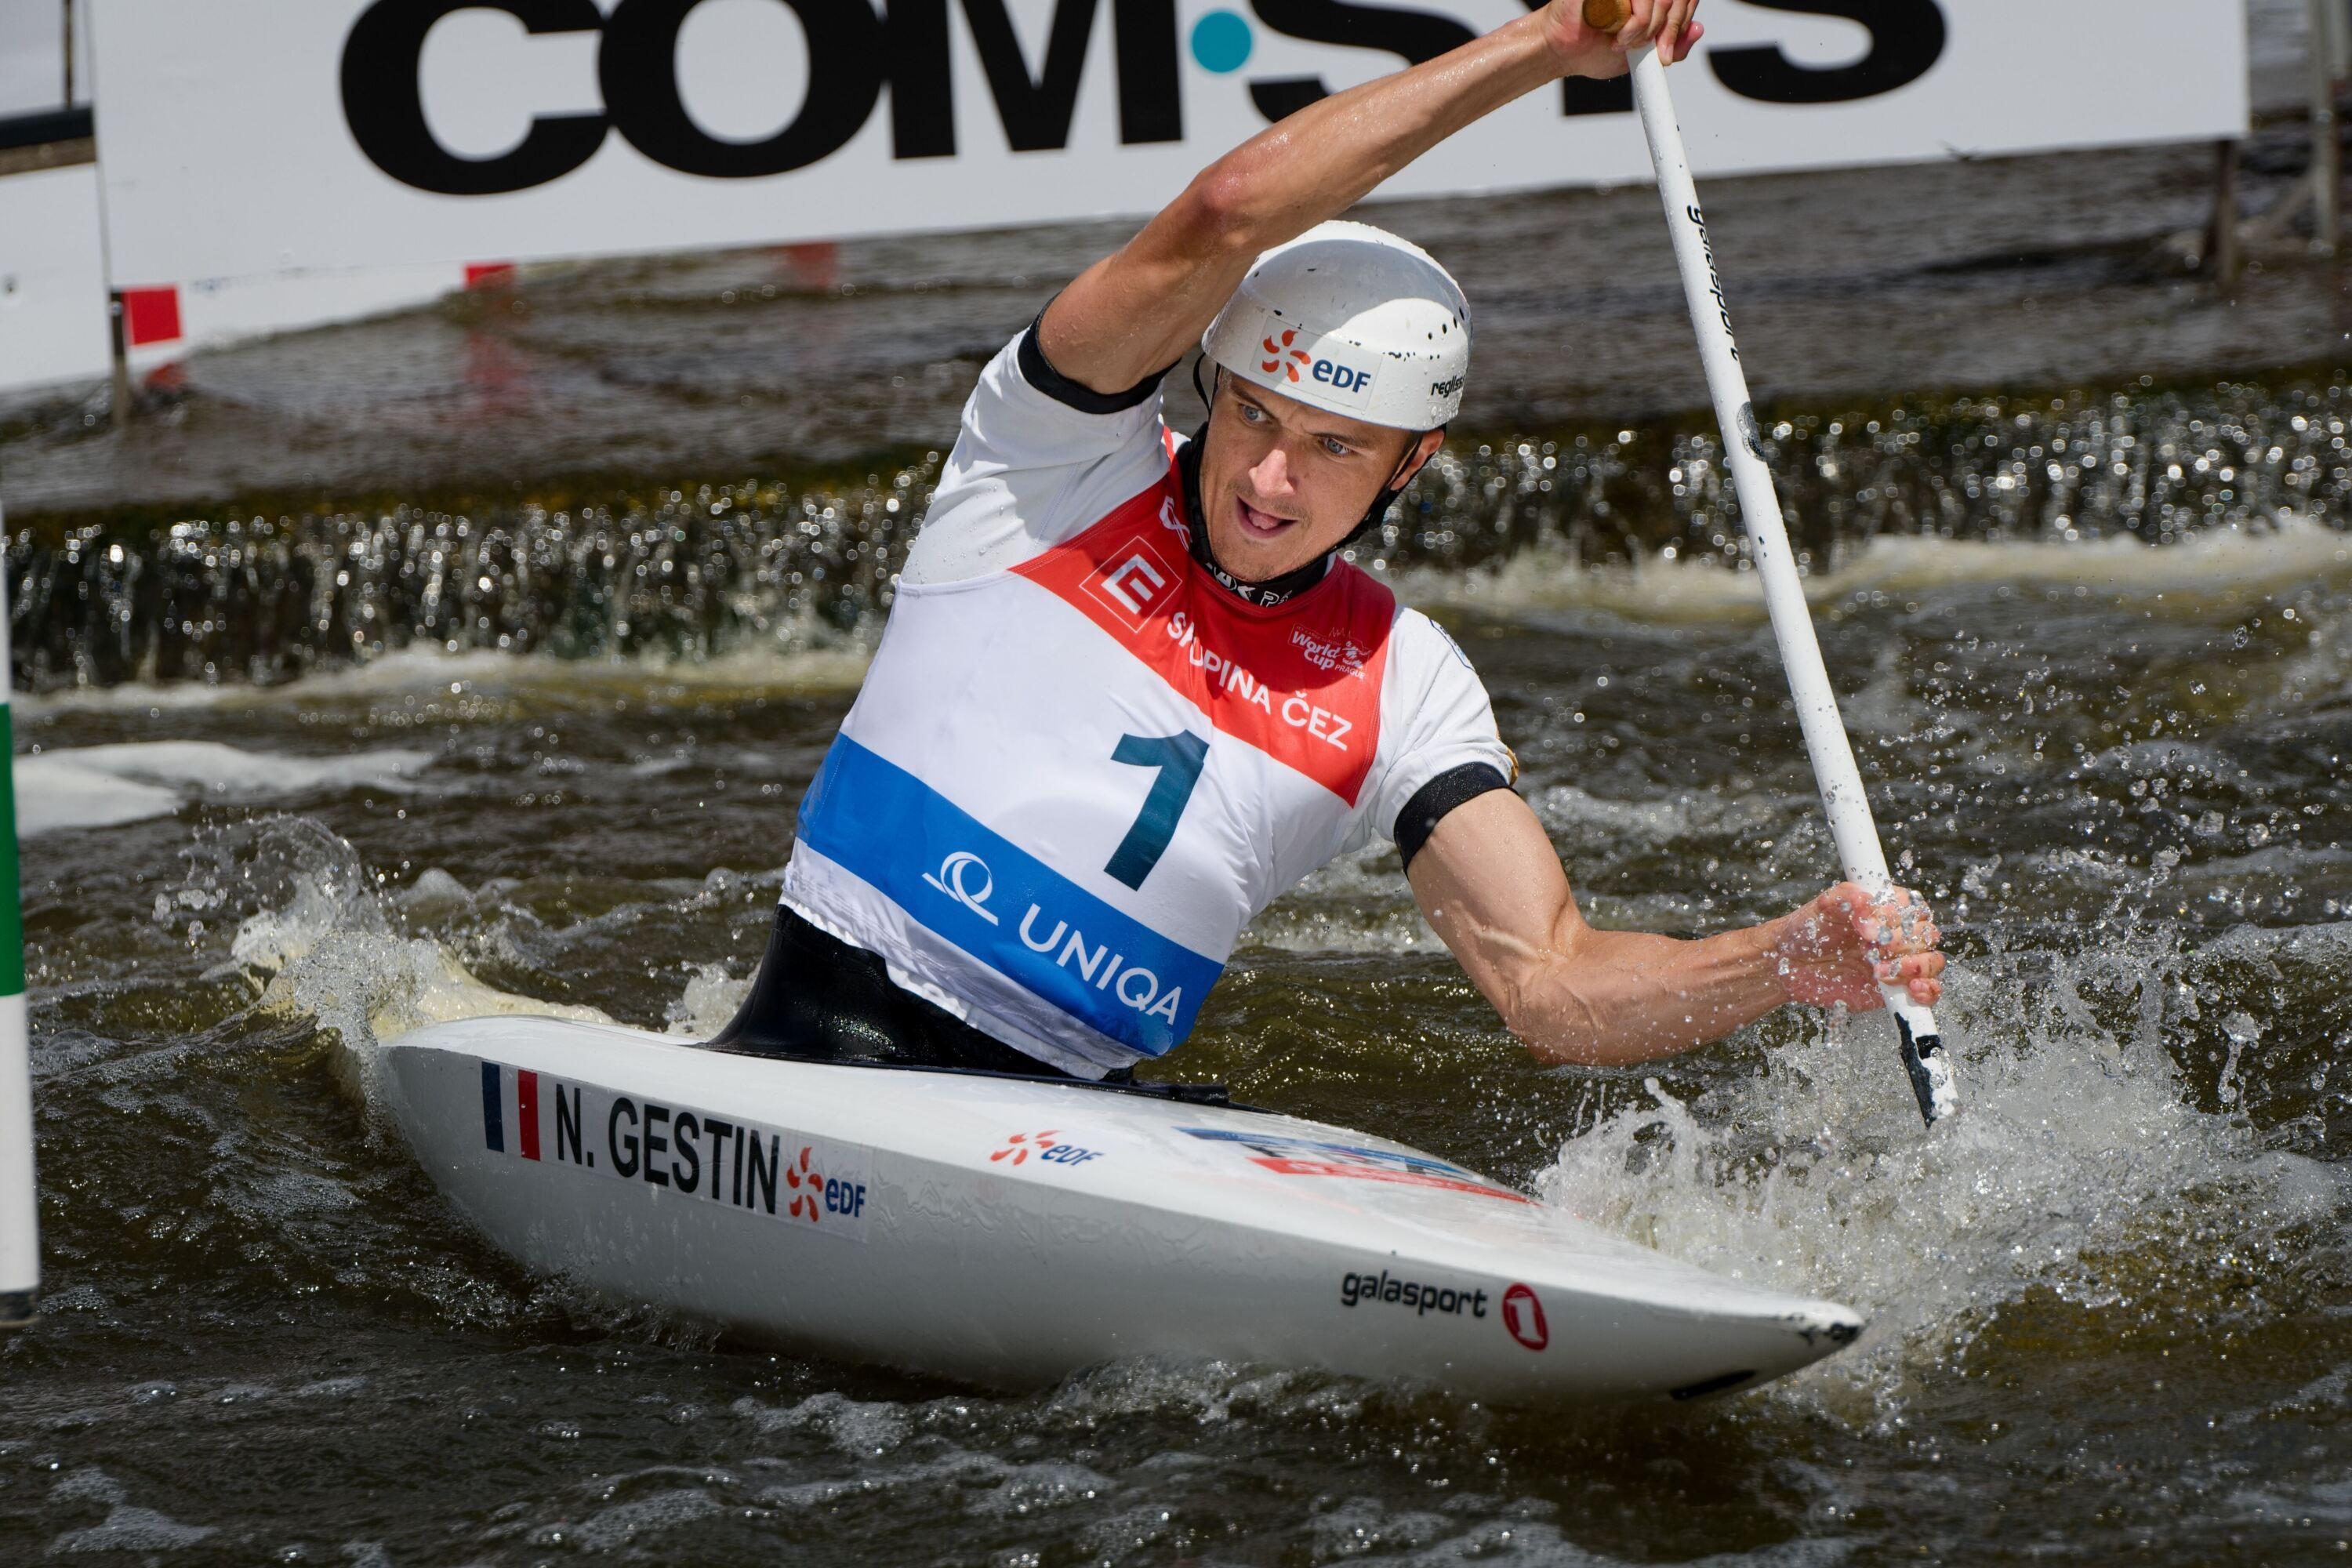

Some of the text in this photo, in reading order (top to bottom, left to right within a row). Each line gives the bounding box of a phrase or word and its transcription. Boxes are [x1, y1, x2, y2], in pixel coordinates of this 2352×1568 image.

[1292, 630, 1341, 659] World
[1304, 648, 1335, 670] Cup
[1334, 664, 1366, 680] PRAGUE
[1282, 690, 1352, 751] ČEZ
[1103, 729, 1210, 892] 1
[1019, 903, 1183, 1025] UNIQA
[555, 1083, 781, 1215] N. GESTIN
[1341, 1269, 1487, 1318] galasport
